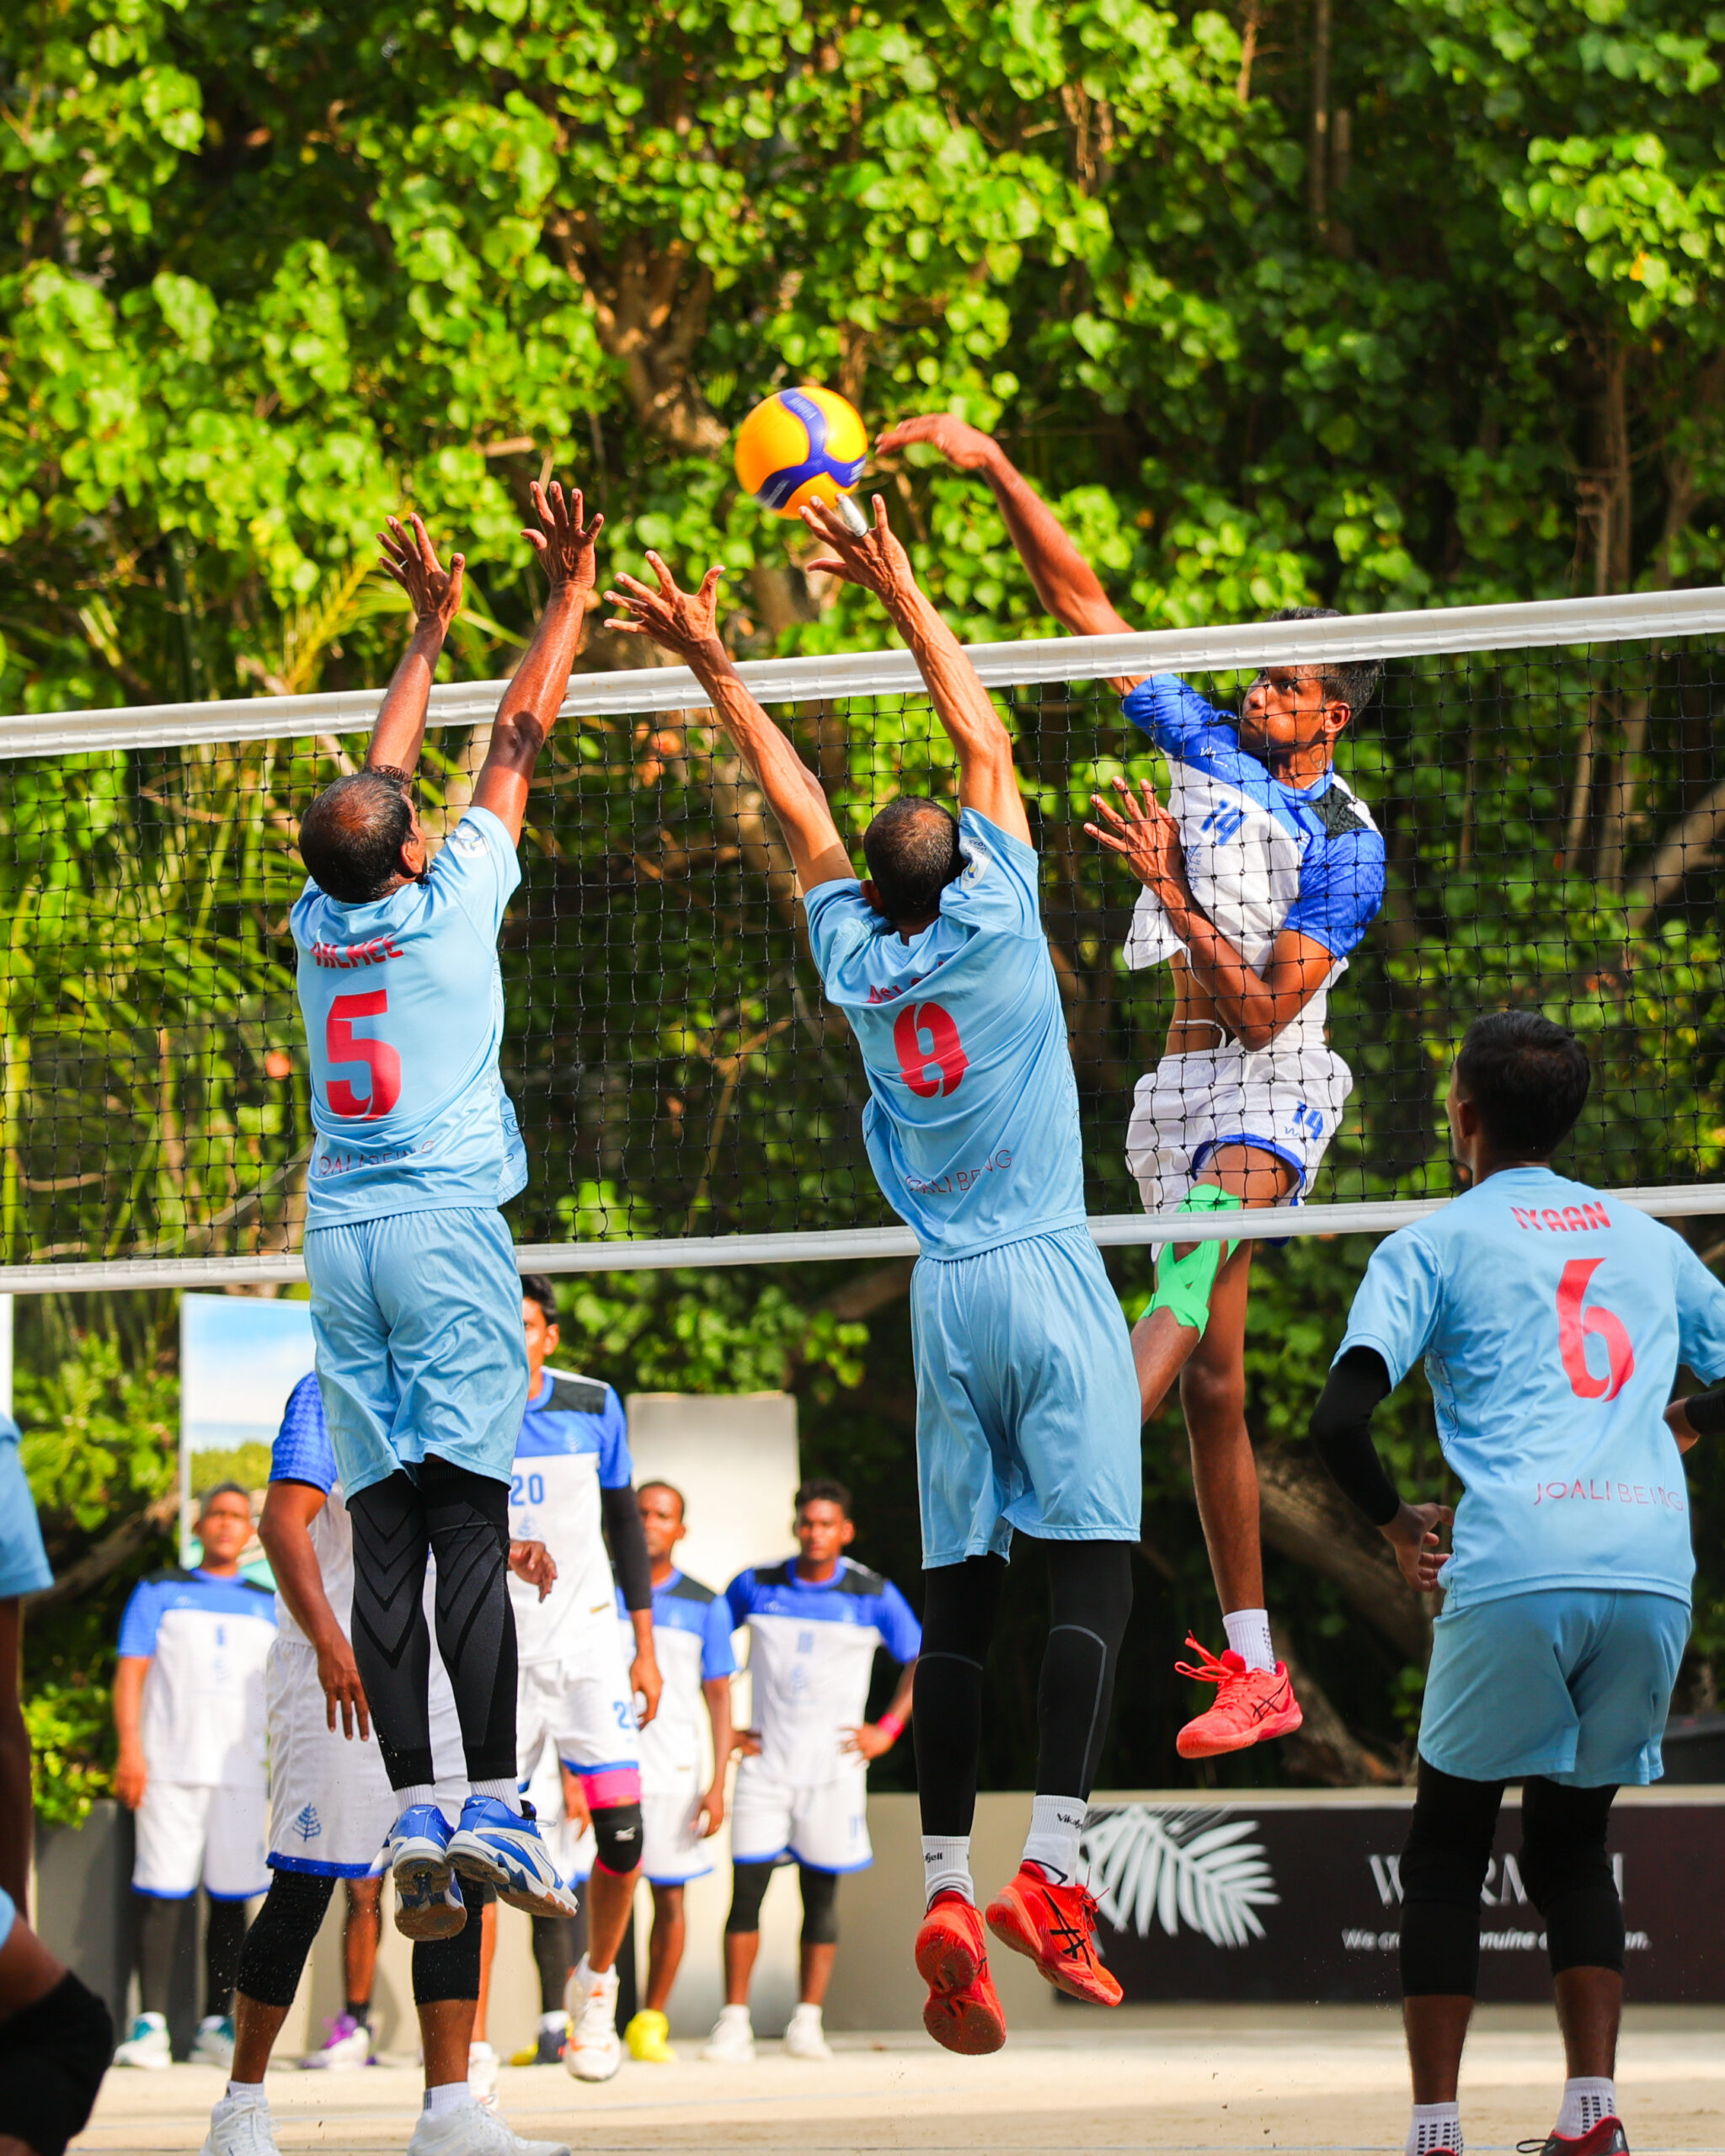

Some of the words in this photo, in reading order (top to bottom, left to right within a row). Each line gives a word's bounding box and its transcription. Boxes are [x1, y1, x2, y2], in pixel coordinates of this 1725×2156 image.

[1199, 798, 1249, 847] 14
[325, 989, 402, 1122] 5
[1509, 1201, 1610, 1231] IYAAN
[1556, 1257, 1634, 1402] 6
[510, 1473, 544, 1506] 20
[1533, 1478, 1610, 1506] JOALI
[1617, 1482, 1684, 1512] BEING
